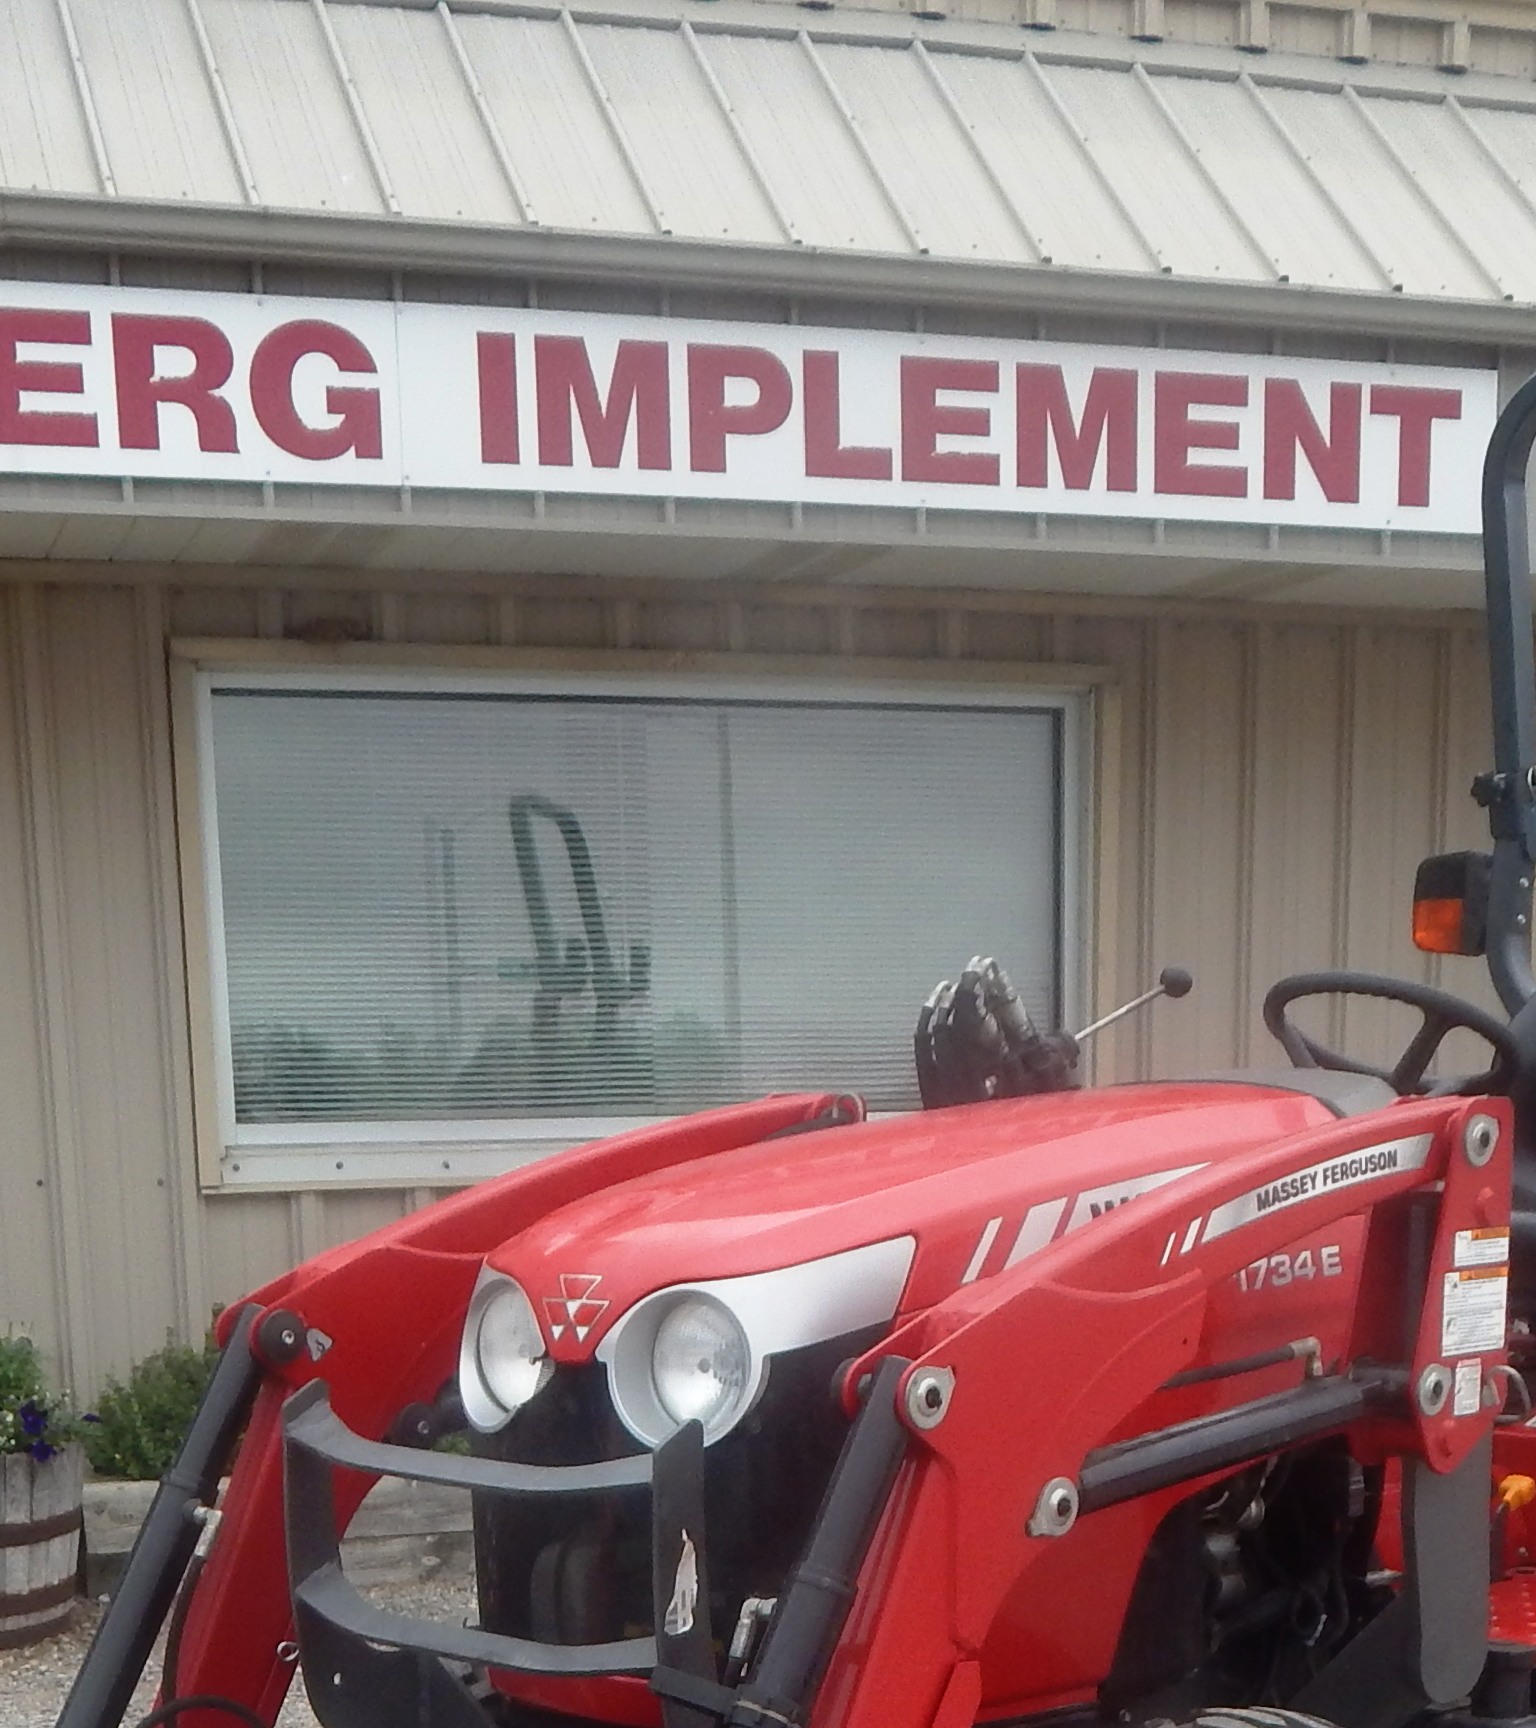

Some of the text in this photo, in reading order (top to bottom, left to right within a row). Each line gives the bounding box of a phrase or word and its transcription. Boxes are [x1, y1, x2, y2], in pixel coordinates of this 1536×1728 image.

[476, 332, 1462, 507] IMPLEMENT
[1256, 1149, 1399, 1213] MASSEY FERGUSON
